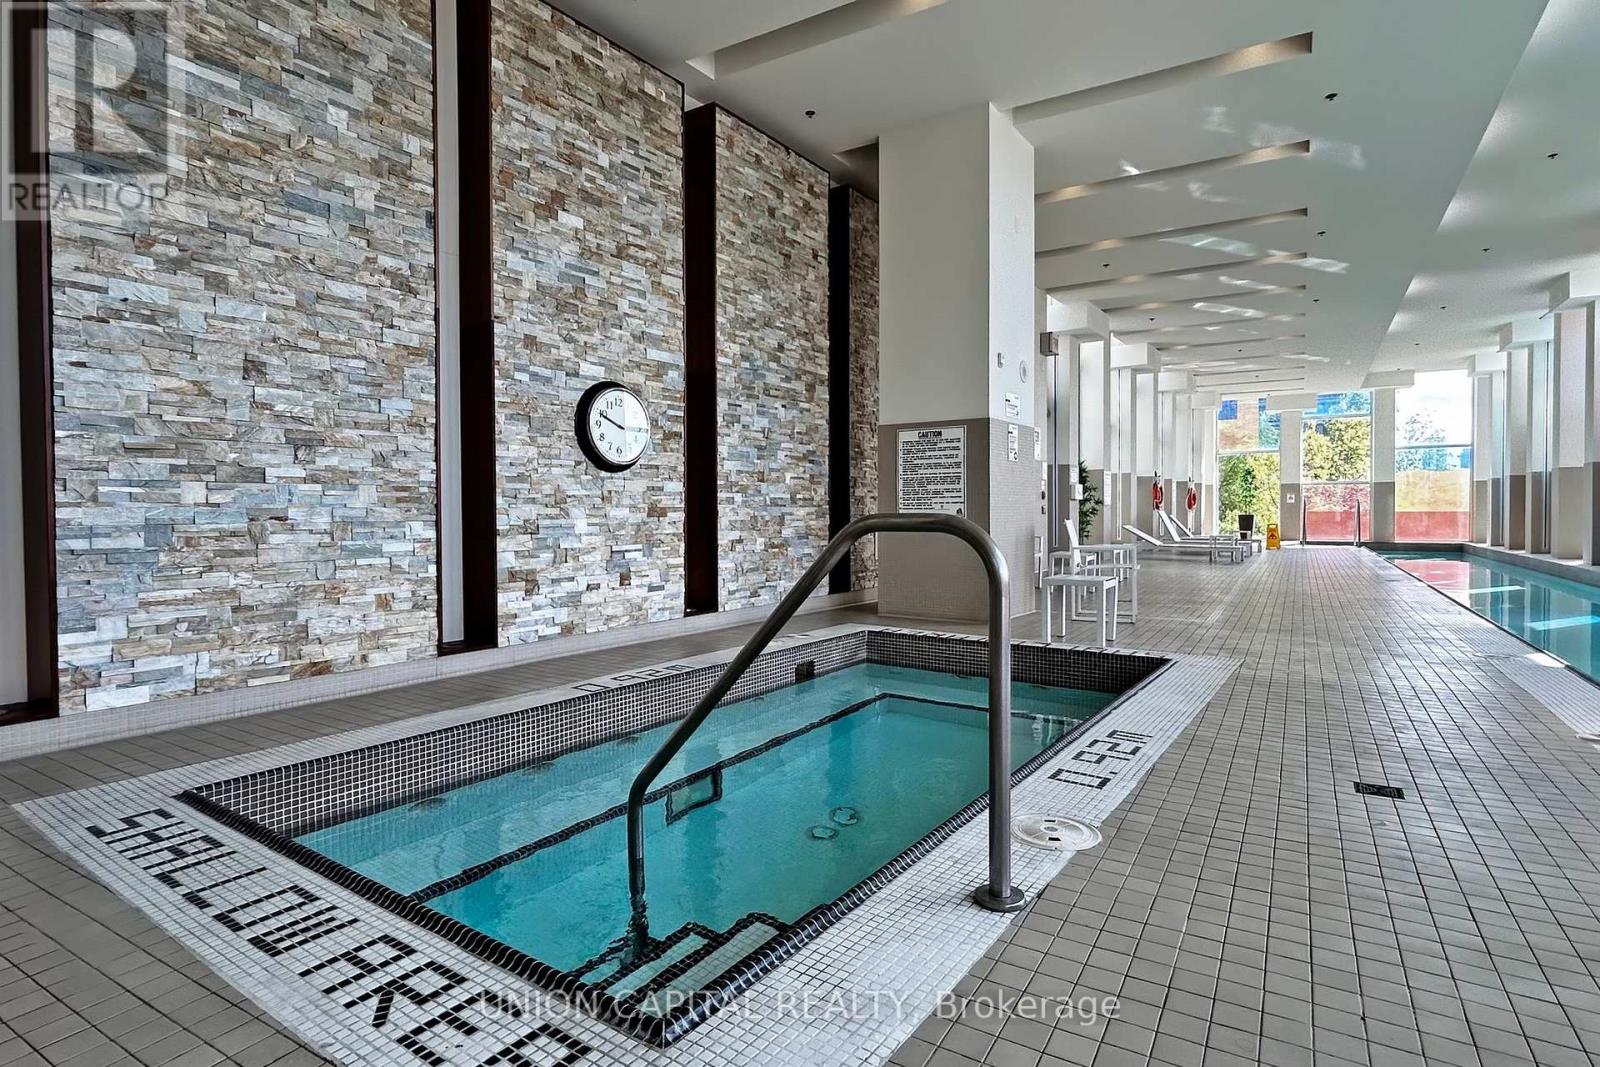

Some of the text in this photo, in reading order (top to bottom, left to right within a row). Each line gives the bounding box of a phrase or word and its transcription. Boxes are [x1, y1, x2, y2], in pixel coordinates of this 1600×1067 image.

[606, 400, 614, 410] 11
[614, 397, 623, 408] 12
[595, 420, 602, 429] 9
[599, 432, 605, 442] 8
[917, 430, 943, 439] CAUTION
[607, 441, 613, 451] 7
[616, 445, 623, 455] 6
[85, 808, 359, 958] SHALLOW
